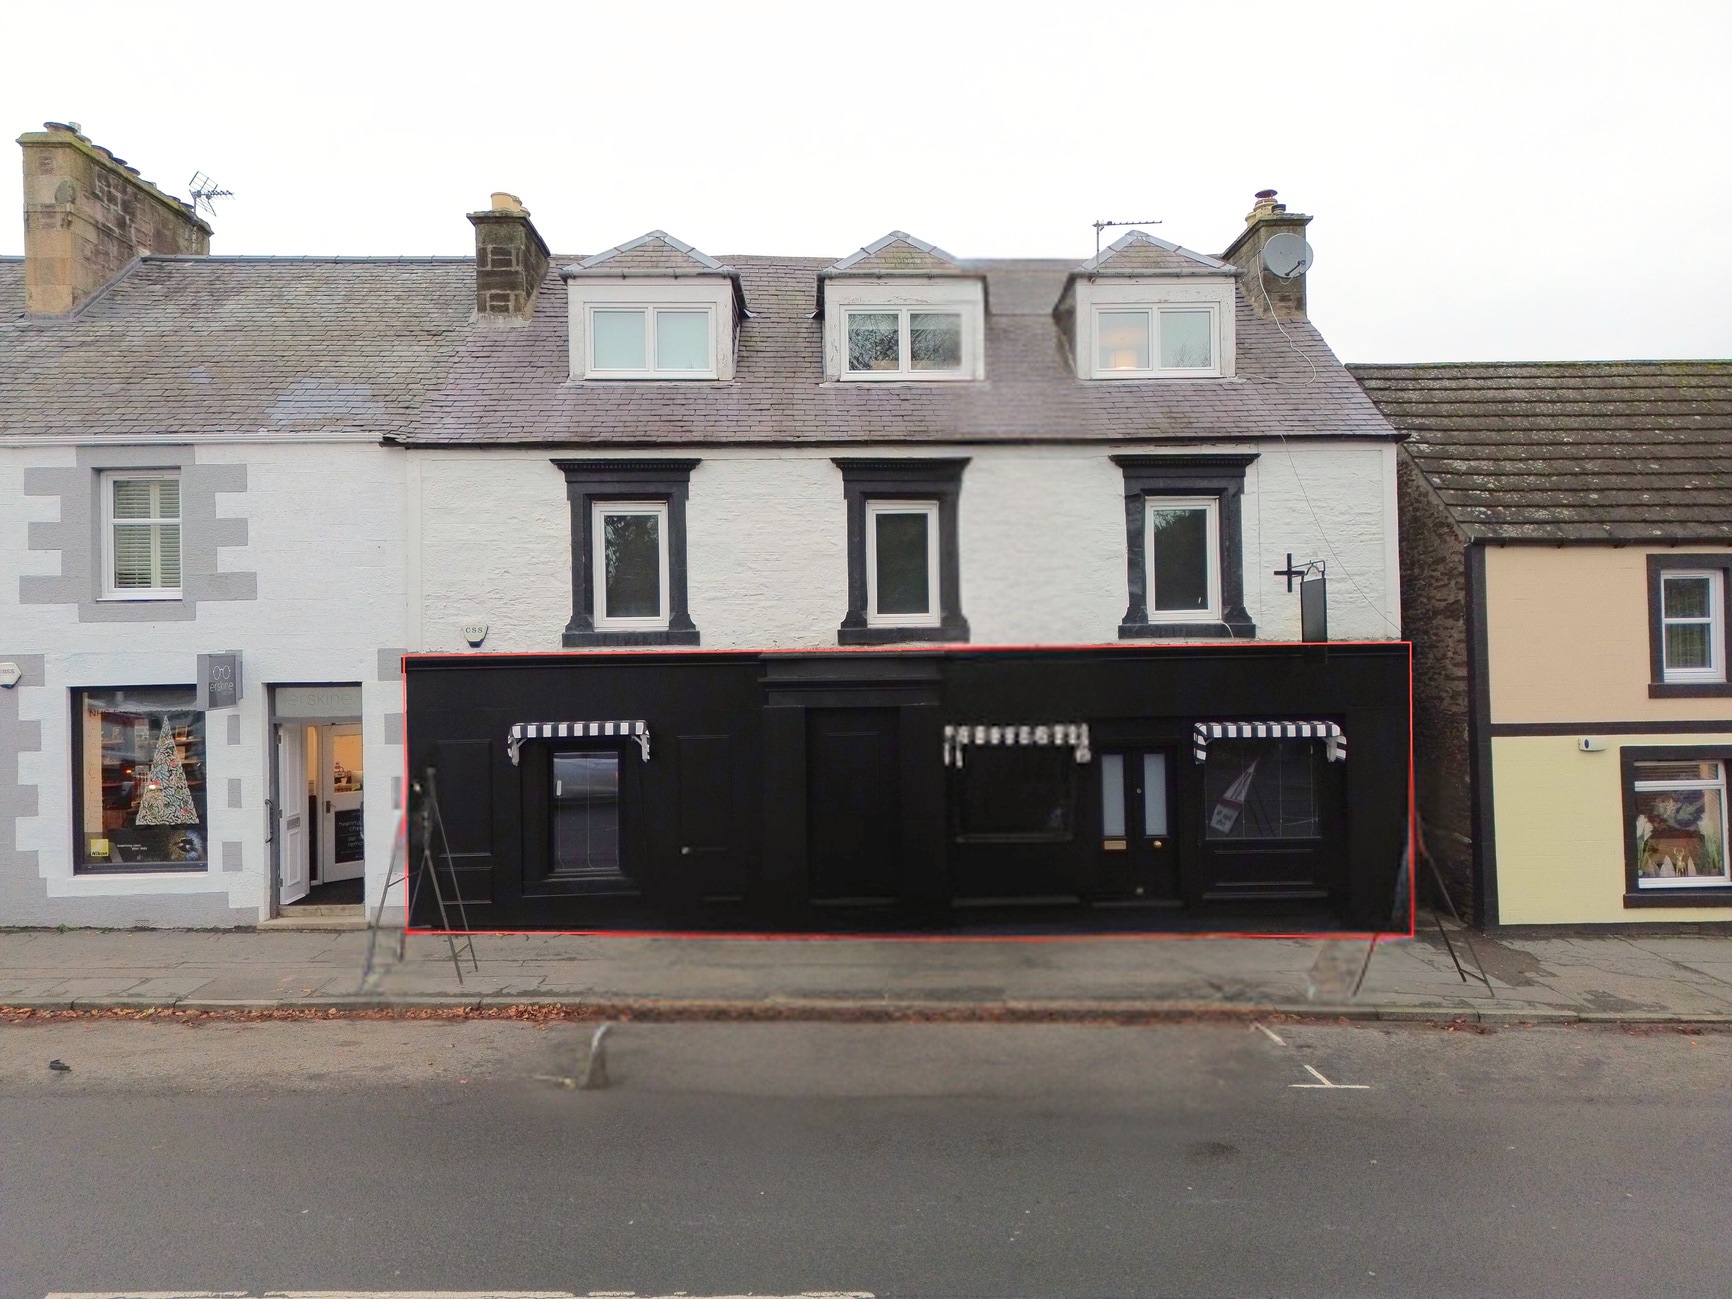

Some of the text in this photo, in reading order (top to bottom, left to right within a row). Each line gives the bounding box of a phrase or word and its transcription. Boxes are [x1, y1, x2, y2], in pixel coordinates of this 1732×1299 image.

[465, 626, 483, 634] CSS
[209, 681, 234, 692] erskine
[287, 690, 353, 706] erskine
